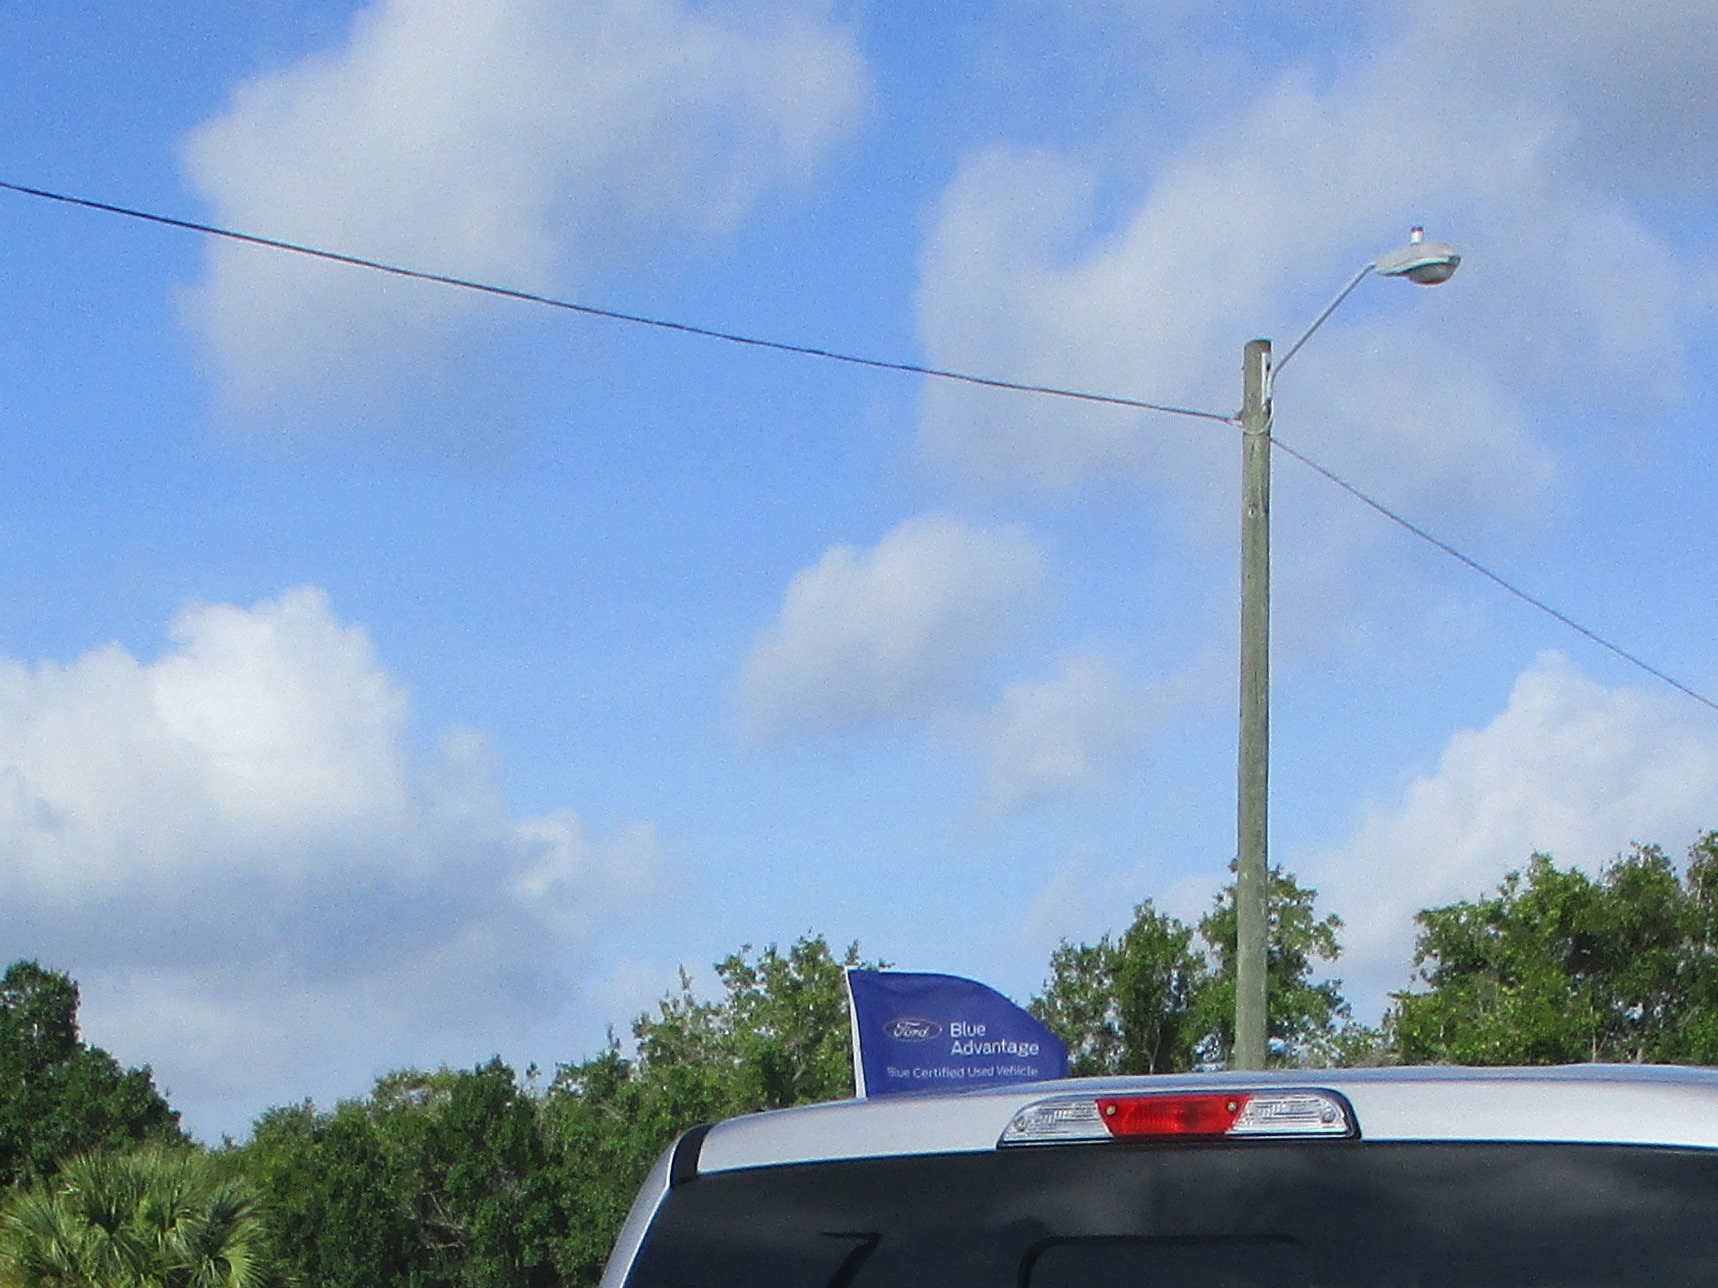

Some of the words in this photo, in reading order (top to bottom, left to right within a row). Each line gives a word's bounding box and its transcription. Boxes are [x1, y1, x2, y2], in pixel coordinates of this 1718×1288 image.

[893, 1022, 931, 1039] Ford
[950, 1022, 986, 1038] Blue
[950, 1039, 1040, 1057] Advantage
[913, 1066, 965, 1079] Certified
[967, 1065, 994, 1077] Used
[996, 1064, 1039, 1076] Vehicle
